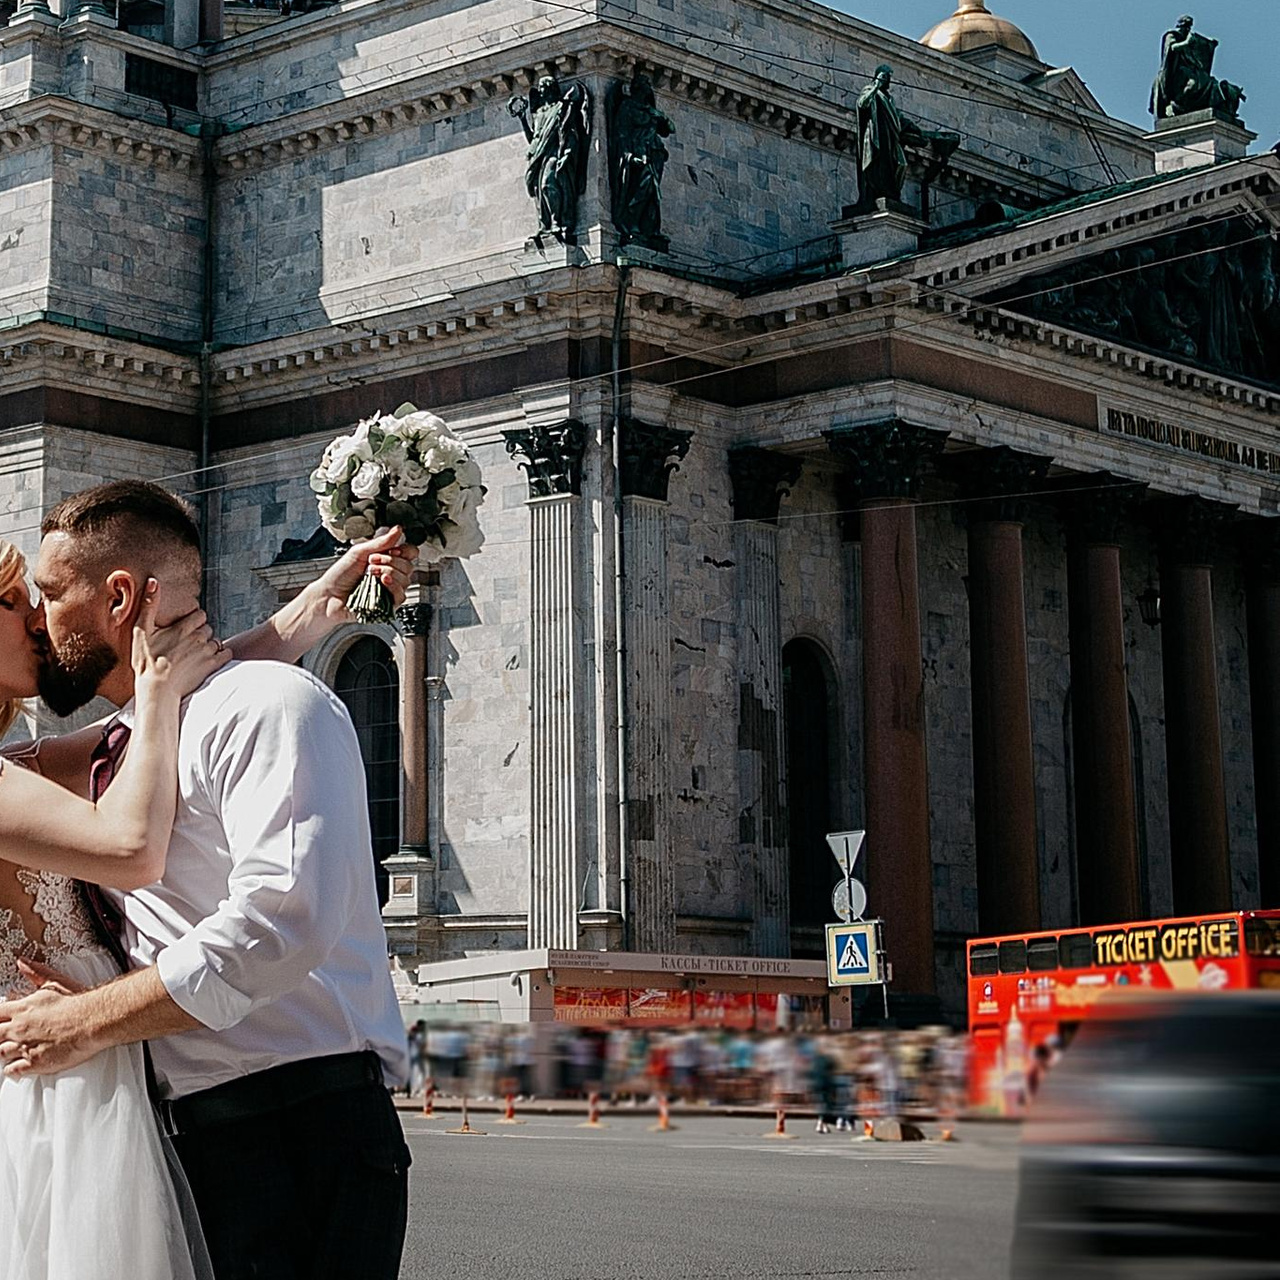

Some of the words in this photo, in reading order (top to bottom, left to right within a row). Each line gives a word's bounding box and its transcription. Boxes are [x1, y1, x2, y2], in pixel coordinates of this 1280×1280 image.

[1095, 929, 1157, 965] TICKET
[1161, 923, 1233, 959] OFFICE
[661, 957, 700, 970] КАССЫ
[708, 958, 748, 972] TICKET
[752, 960, 791, 974] OFFICE
